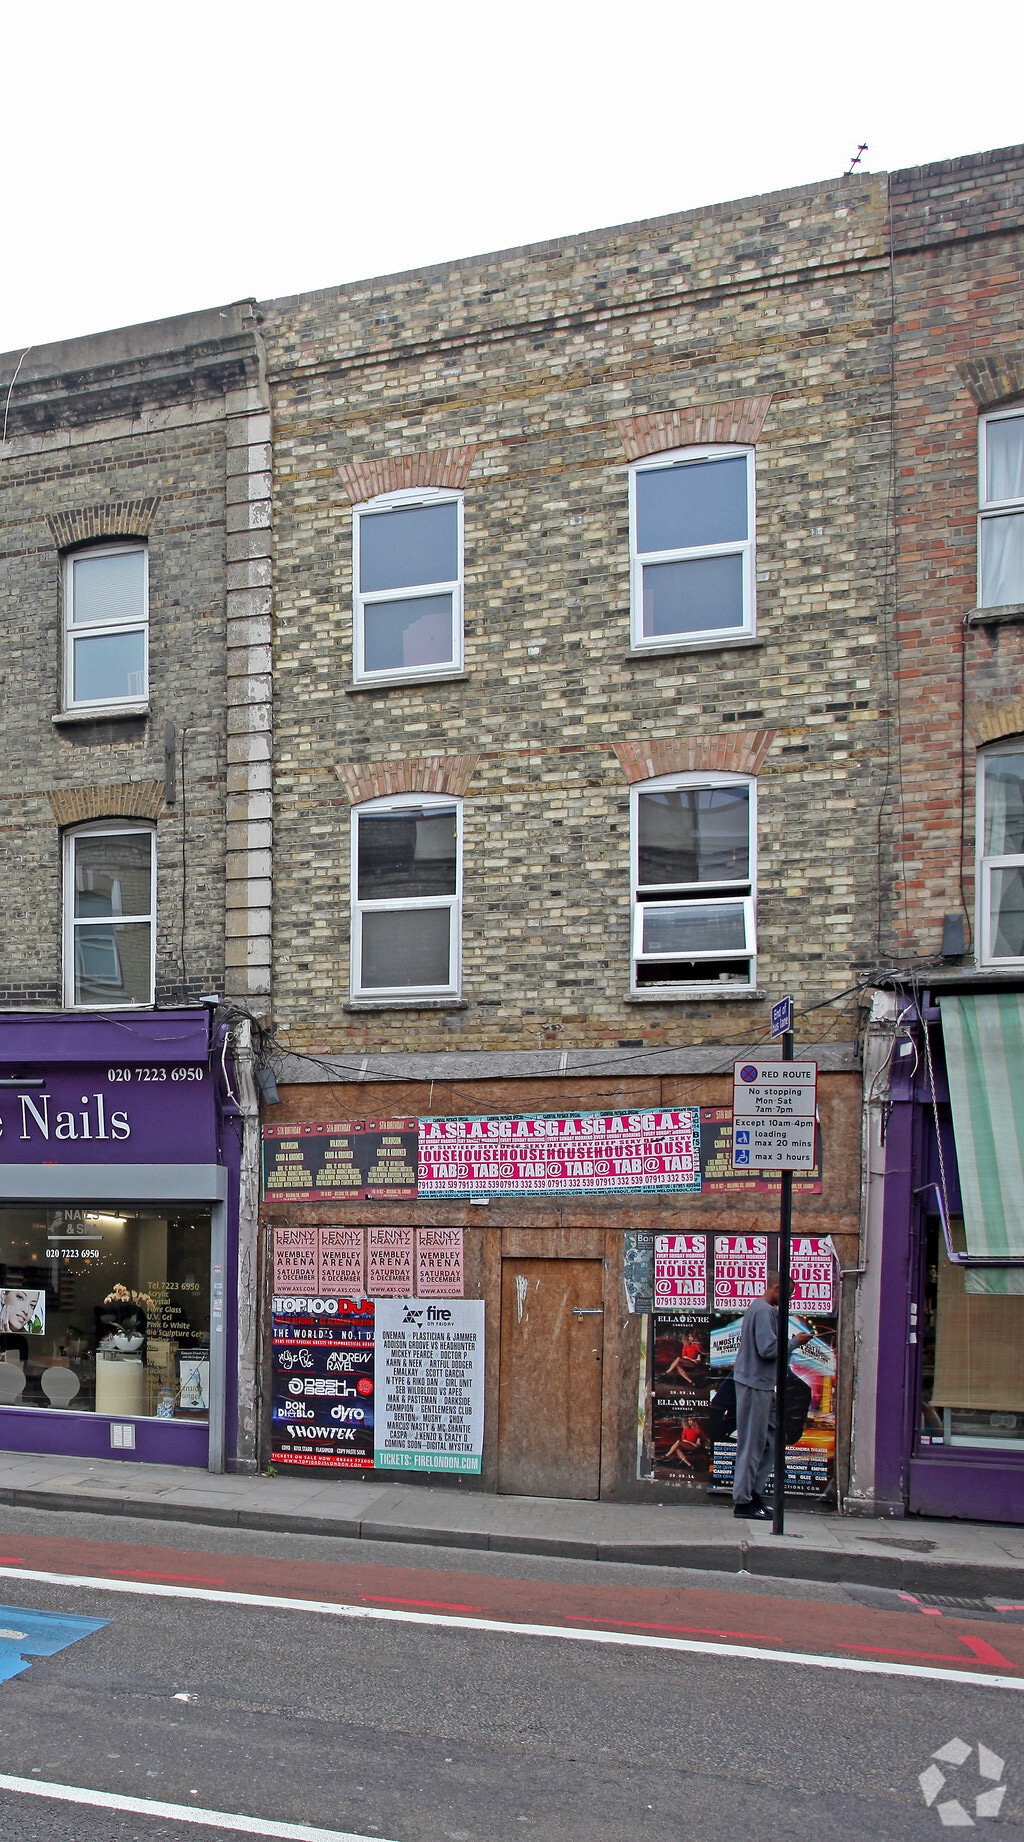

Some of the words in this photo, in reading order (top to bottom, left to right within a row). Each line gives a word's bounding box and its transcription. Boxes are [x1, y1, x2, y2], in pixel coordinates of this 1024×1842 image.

[773, 1006, 781, 1020] End
[107, 1069, 131, 1082] 020
[136, 1068, 168, 1081] 7223
[171, 1067, 204, 1081] 6950
[765, 1088, 802, 1096] stopping
[18, 1093, 131, 1140] Nails
[642, 1112, 691, 1131] G.A.S
[499, 1120, 545, 1137] G.A.S
[546, 1120, 593, 1136] G.A.S
[593, 1116, 641, 1134] G.A.S
[736, 1119, 765, 1127] Except
[755, 1131, 787, 1139] loading
[644, 1141, 692, 1155] HOUSE
[776, 1139, 788, 1147] 20
[500, 1149, 545, 1160] HOUSE
[595, 1145, 641, 1158] HOUSE
[644, 1158, 660, 1173] @
[662, 1156, 693, 1171] TAB
[645, 1175, 665, 1183] 07913
[667, 1174, 679, 1182] 332
[682, 1173, 693, 1181] 539
[64, 1209, 99, 1220] NAILS
[66, 1223, 74, 1234] &
[76, 1223, 98, 1234] SPA
[371, 1230, 410, 1238] LENNY
[656, 1236, 705, 1253] G.A.S
[716, 1237, 766, 1254] G.A.S
[46, 1249, 59, 1258] 020
[61, 1249, 79, 1258] 7223
[81, 1249, 99, 1258] 6950
[420, 1259, 460, 1267] ARENA
[656, 1265, 704, 1277] HOUSE
[716, 1266, 765, 1278] HOUSE
[181, 1282, 200, 1290] 6950
[656, 1280, 671, 1294] @
[675, 1280, 704, 1294] TAB
[735, 1281, 765, 1296] TAB
[799, 1284, 830, 1298] TAB
[427, 1306, 451, 1320] fire
[658, 1315, 679, 1323] ELLA
[158, 1329, 189, 1337] Sculpture
[273, 1329, 288, 1337] THE
[294, 1329, 333, 1339] WORLD'S
[383, 1331, 405, 1339] ONEMAN
[413, 1332, 444, 1340] PLASTICIAN
[453, 1333, 476, 1341] JAMMER
[440, 1342, 475, 1350] HEADHUNTER
[328, 1352, 372, 1363] ANDREW
[391, 1350, 411, 1358] MICKEY
[441, 1351, 461, 1359] DOCTOR
[326, 1361, 354, 1371] RAYEL
[394, 1368, 418, 1376] EMALKAY
[285, 1401, 306, 1410] DON
[408, 1395, 437, 1404] PASTEMAN
[444, 1397, 470, 1405] DARKSIDE
[278, 1408, 315, 1418] DIABLO
[331, 1404, 364, 1421] dyro
[286, 1425, 356, 1440] SHOWTEK
[449, 1443, 473, 1452] MYSTIKZ
[379, 1453, 411, 1465] TICKETS:
[414, 1455, 478, 1470] FIRELONDON.COM
